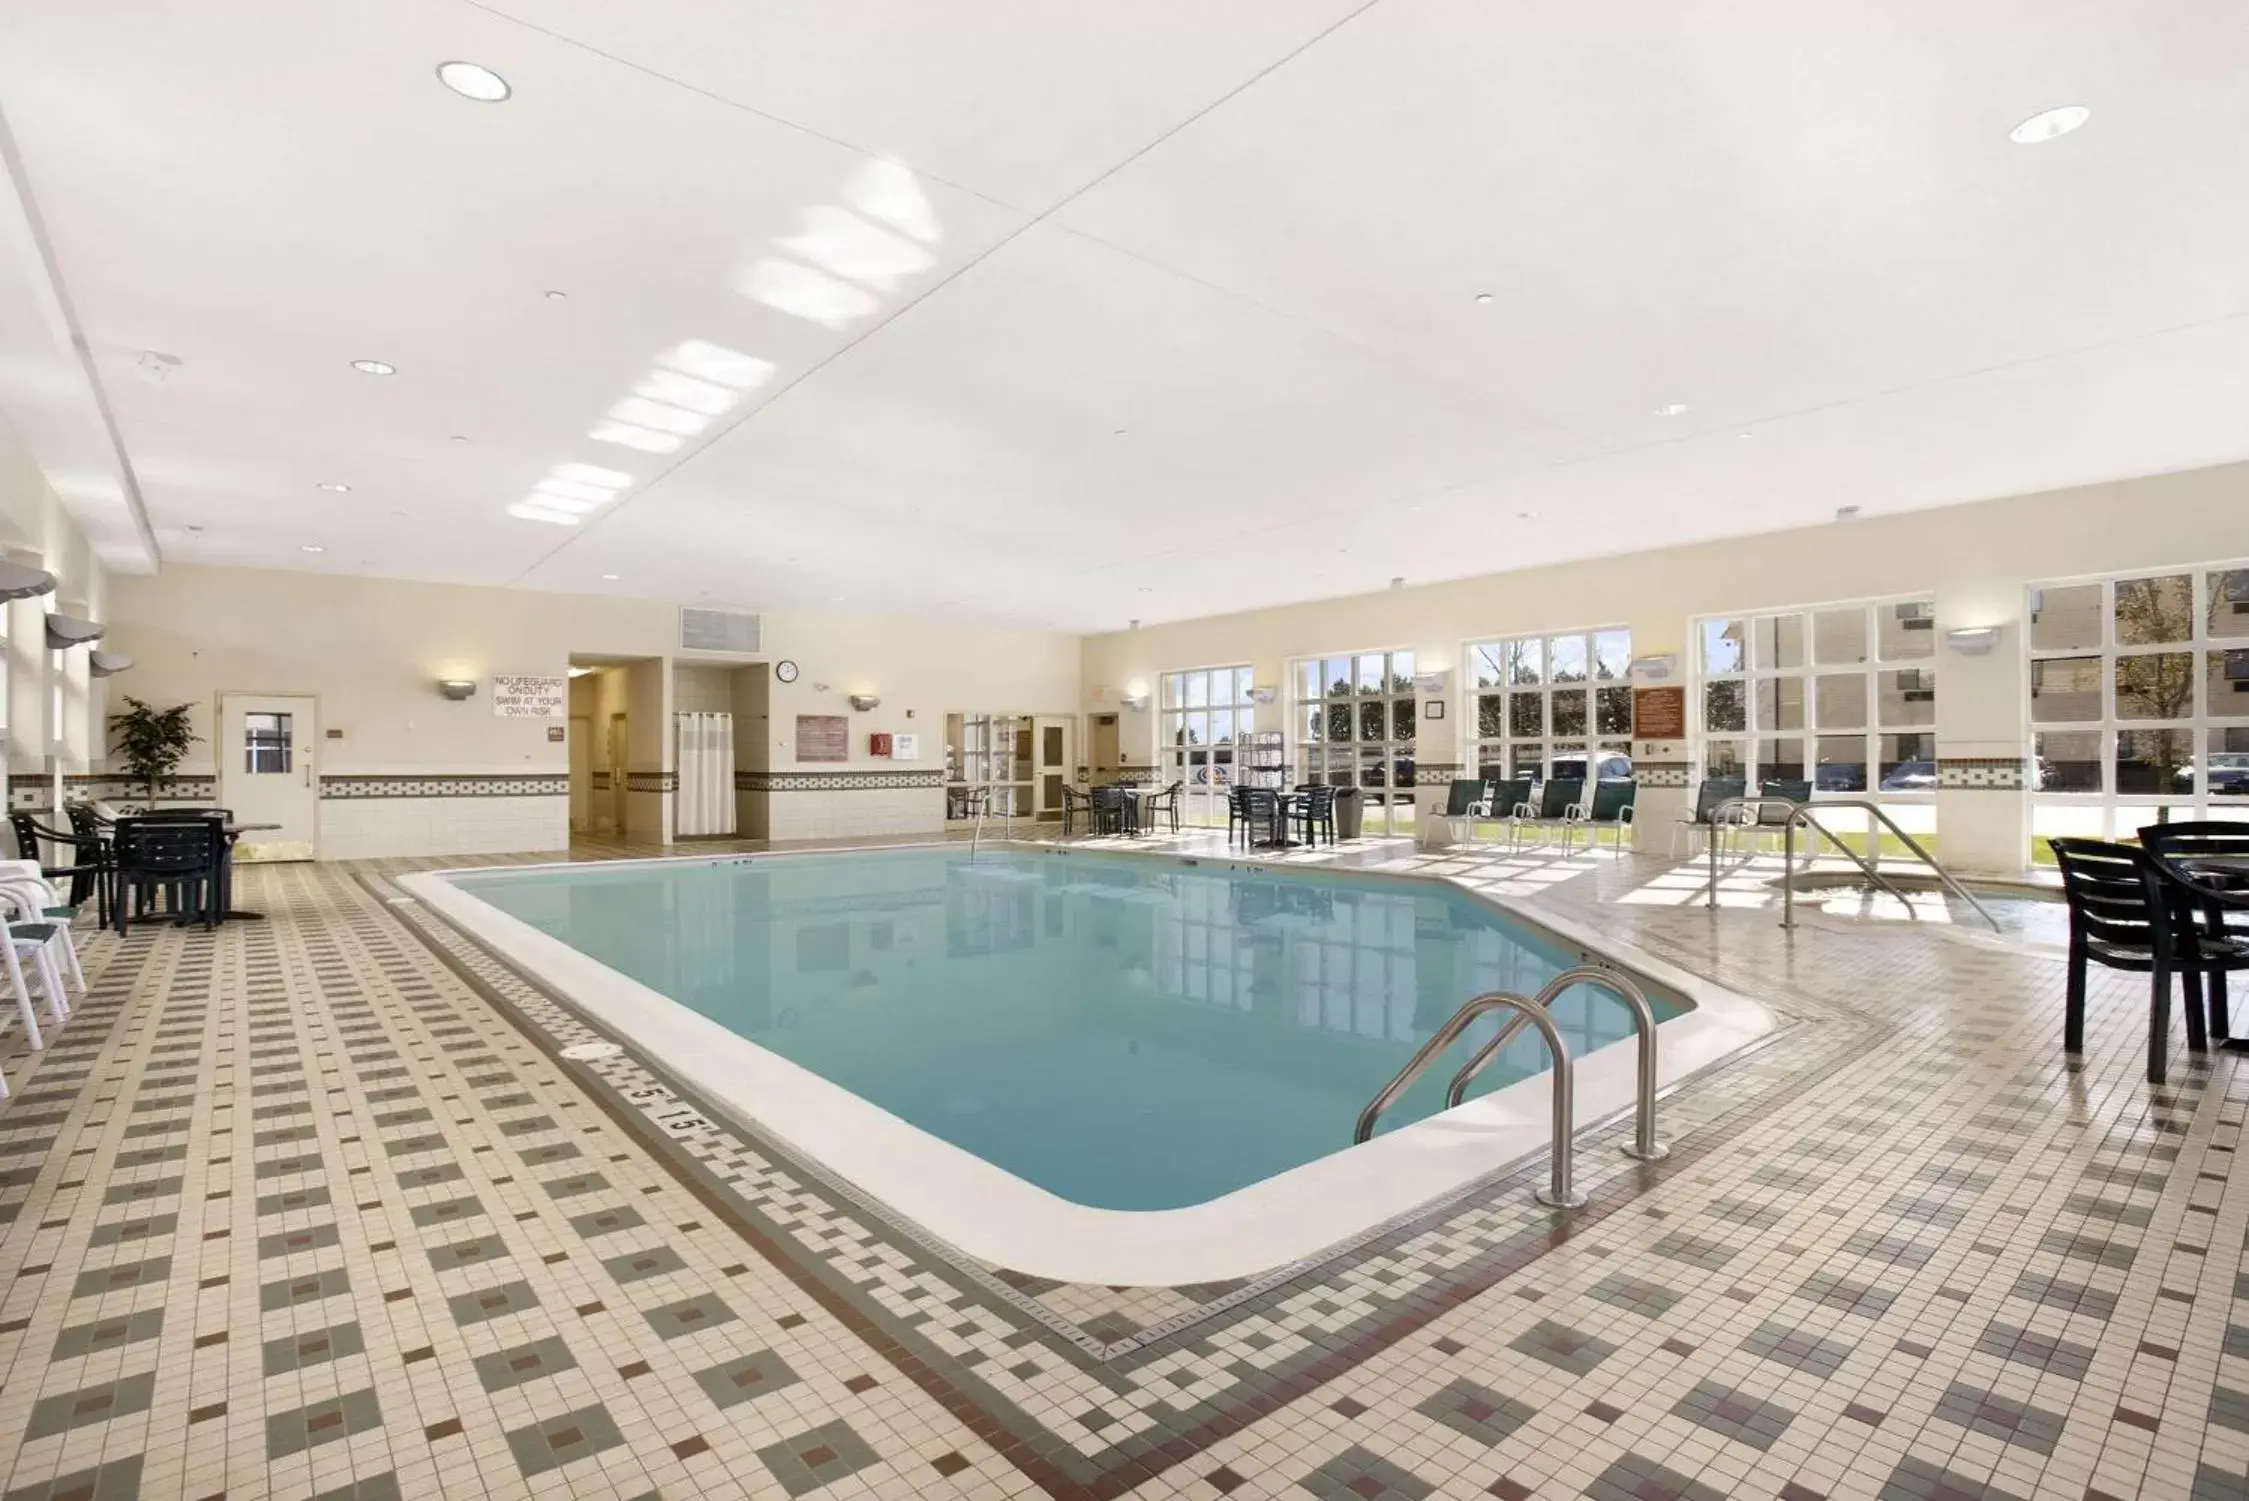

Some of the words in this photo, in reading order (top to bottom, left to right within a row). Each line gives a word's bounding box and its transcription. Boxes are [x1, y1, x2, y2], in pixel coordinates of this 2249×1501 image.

[496, 677, 509, 685] NO
[511, 678, 562, 687] LIFEGUARD
[508, 686, 523, 694] ON
[524, 687, 549, 695] DUTY
[496, 696, 521, 705] SWIM
[523, 697, 533, 705] AT
[539, 697, 562, 705] YOUR
